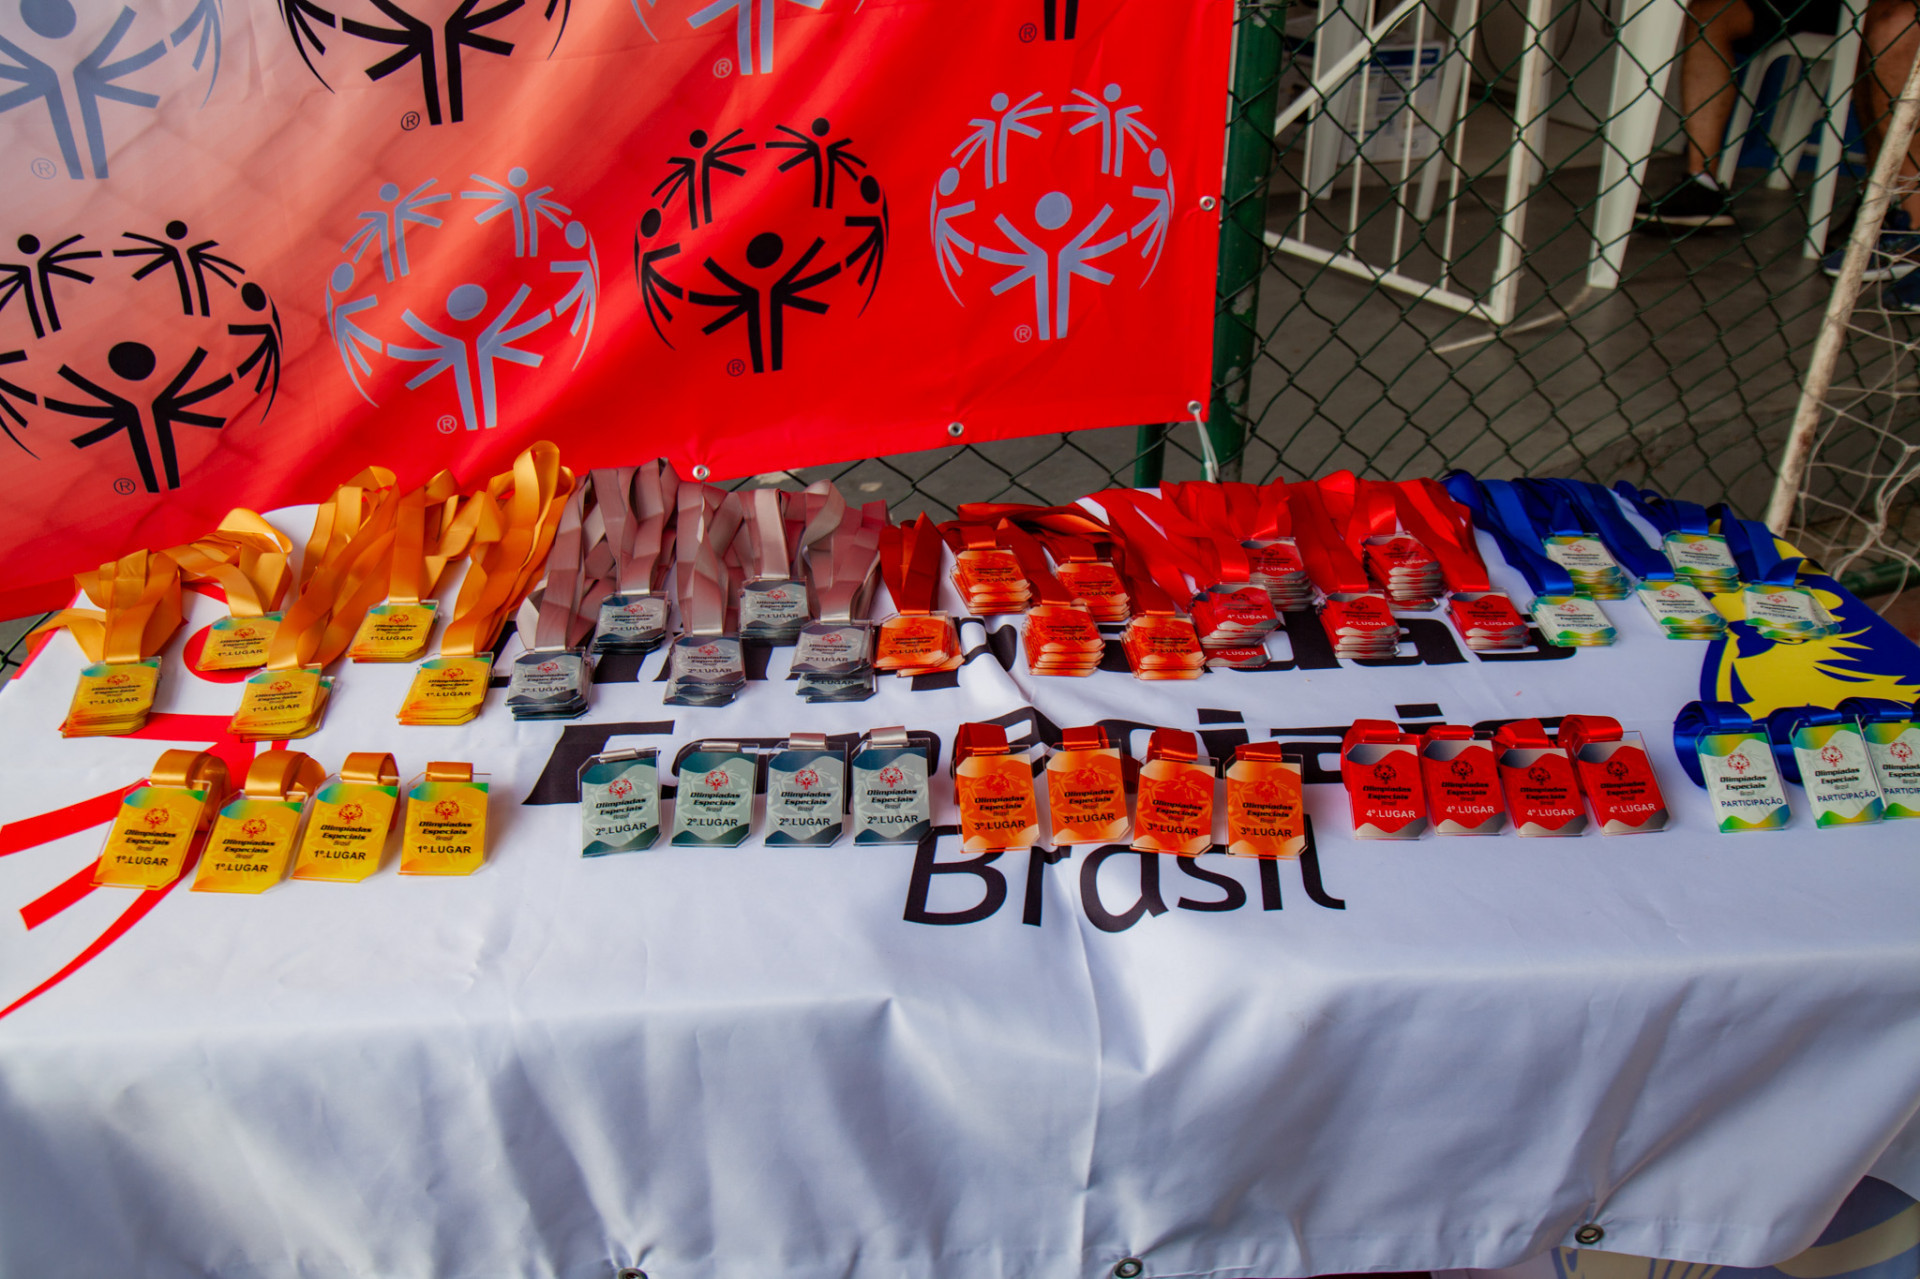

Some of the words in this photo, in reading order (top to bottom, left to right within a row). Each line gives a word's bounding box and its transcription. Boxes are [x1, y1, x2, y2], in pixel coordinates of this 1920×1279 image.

[1816, 790, 1877, 803] PARTICIPAÇÃO
[1720, 797, 1783, 808] PARTICIPAÇÃO
[1366, 809, 1417, 819] 4º.LUGAR
[1446, 805, 1495, 814] 4º.LUGAR
[1526, 808, 1576, 817] 4º.LUGAR
[1609, 803, 1656, 814] 4º.LUGAR
[686, 818, 738, 827] 2º.LUGAR
[779, 817, 831, 826] 2º.LUGAR
[867, 815, 919, 825] 2º.LUGAR
[1064, 812, 1116, 824] 3º.LUGAR
[595, 822, 648, 836] 2º.LUGAR
[974, 820, 1026, 831] 3º.LUGAR
[1147, 822, 1199, 836] 3º.LUGAR
[1240, 827, 1293, 838] 3º.LUGAR
[417, 845, 472, 854] 1º.LUGAR
[115, 855, 169, 866] 1º.LUGAR
[313, 850, 367, 861] 1º.LUGAR
[214, 863, 269, 873] 1º.LUGAR
